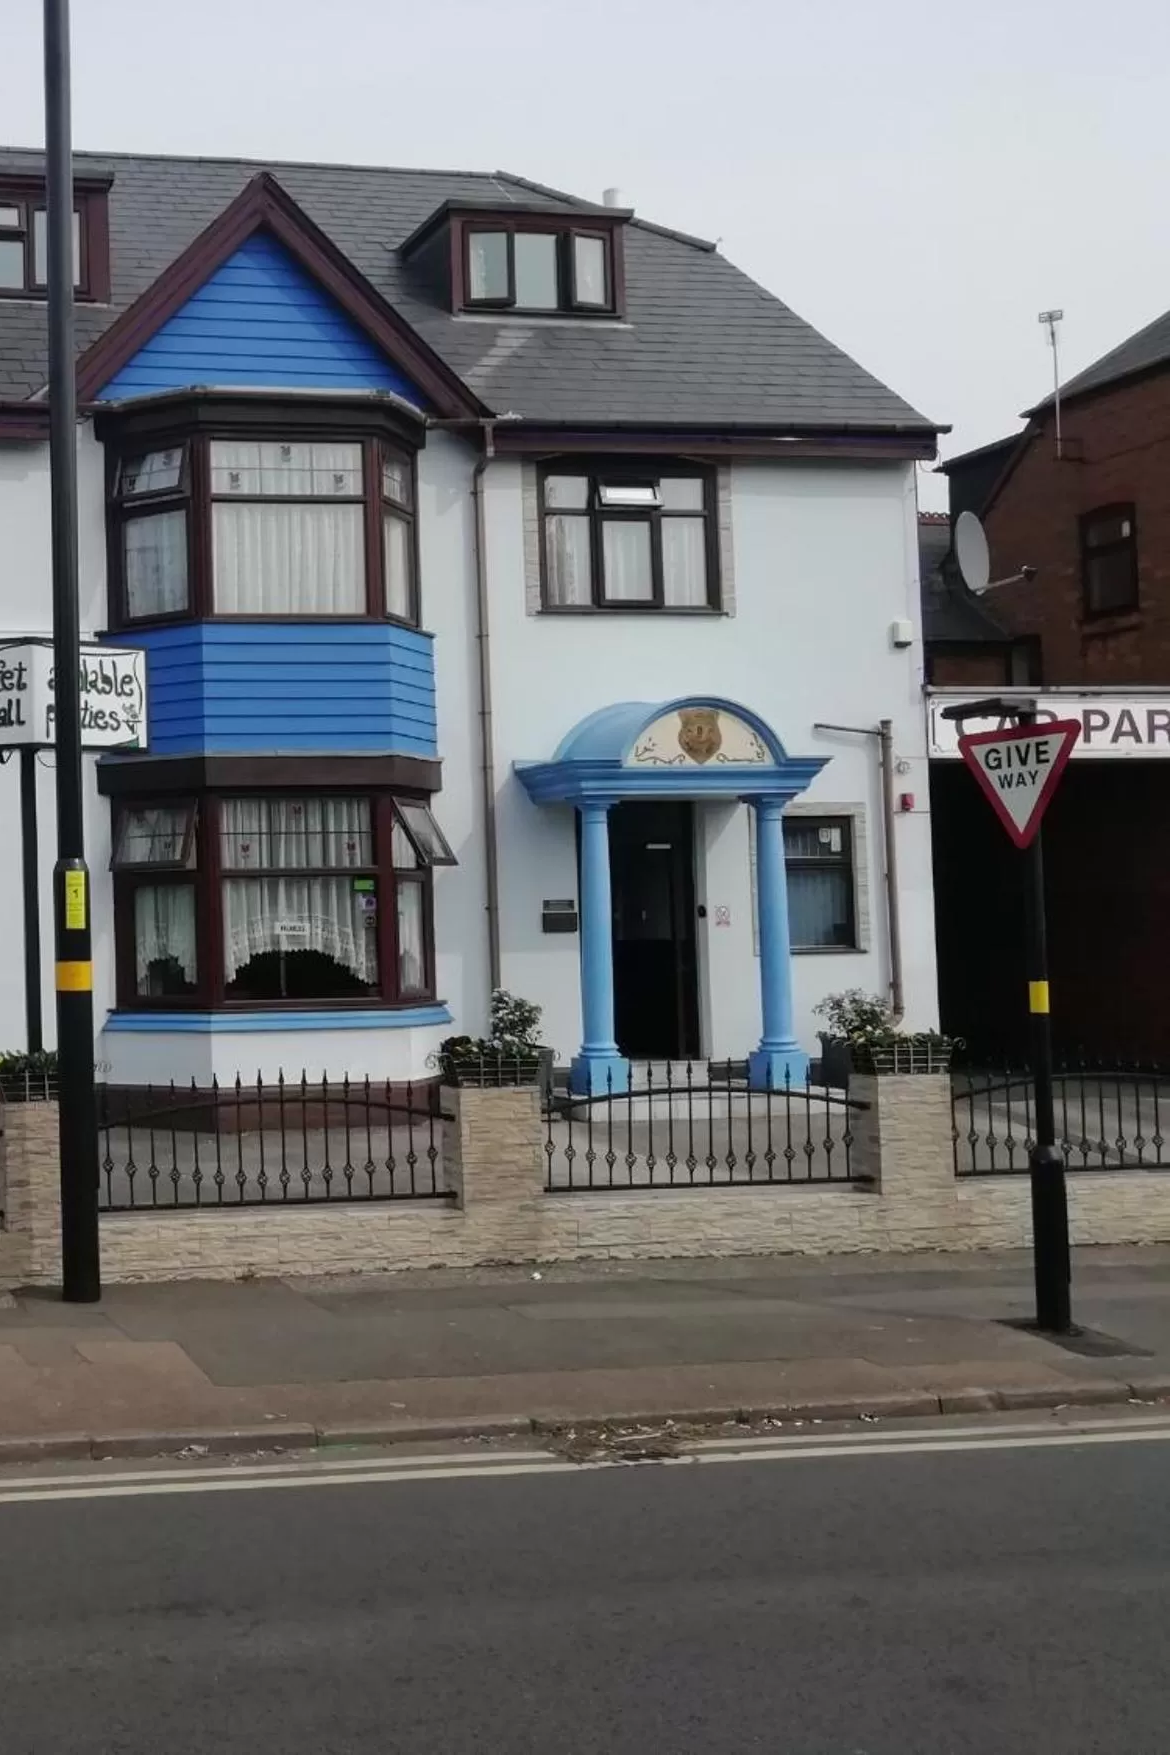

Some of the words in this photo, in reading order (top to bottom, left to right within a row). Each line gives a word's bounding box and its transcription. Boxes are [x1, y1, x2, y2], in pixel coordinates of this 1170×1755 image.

[46, 699, 121, 739] pties
[984, 740, 1050, 771] GIVE
[998, 771, 1039, 789] WAY
